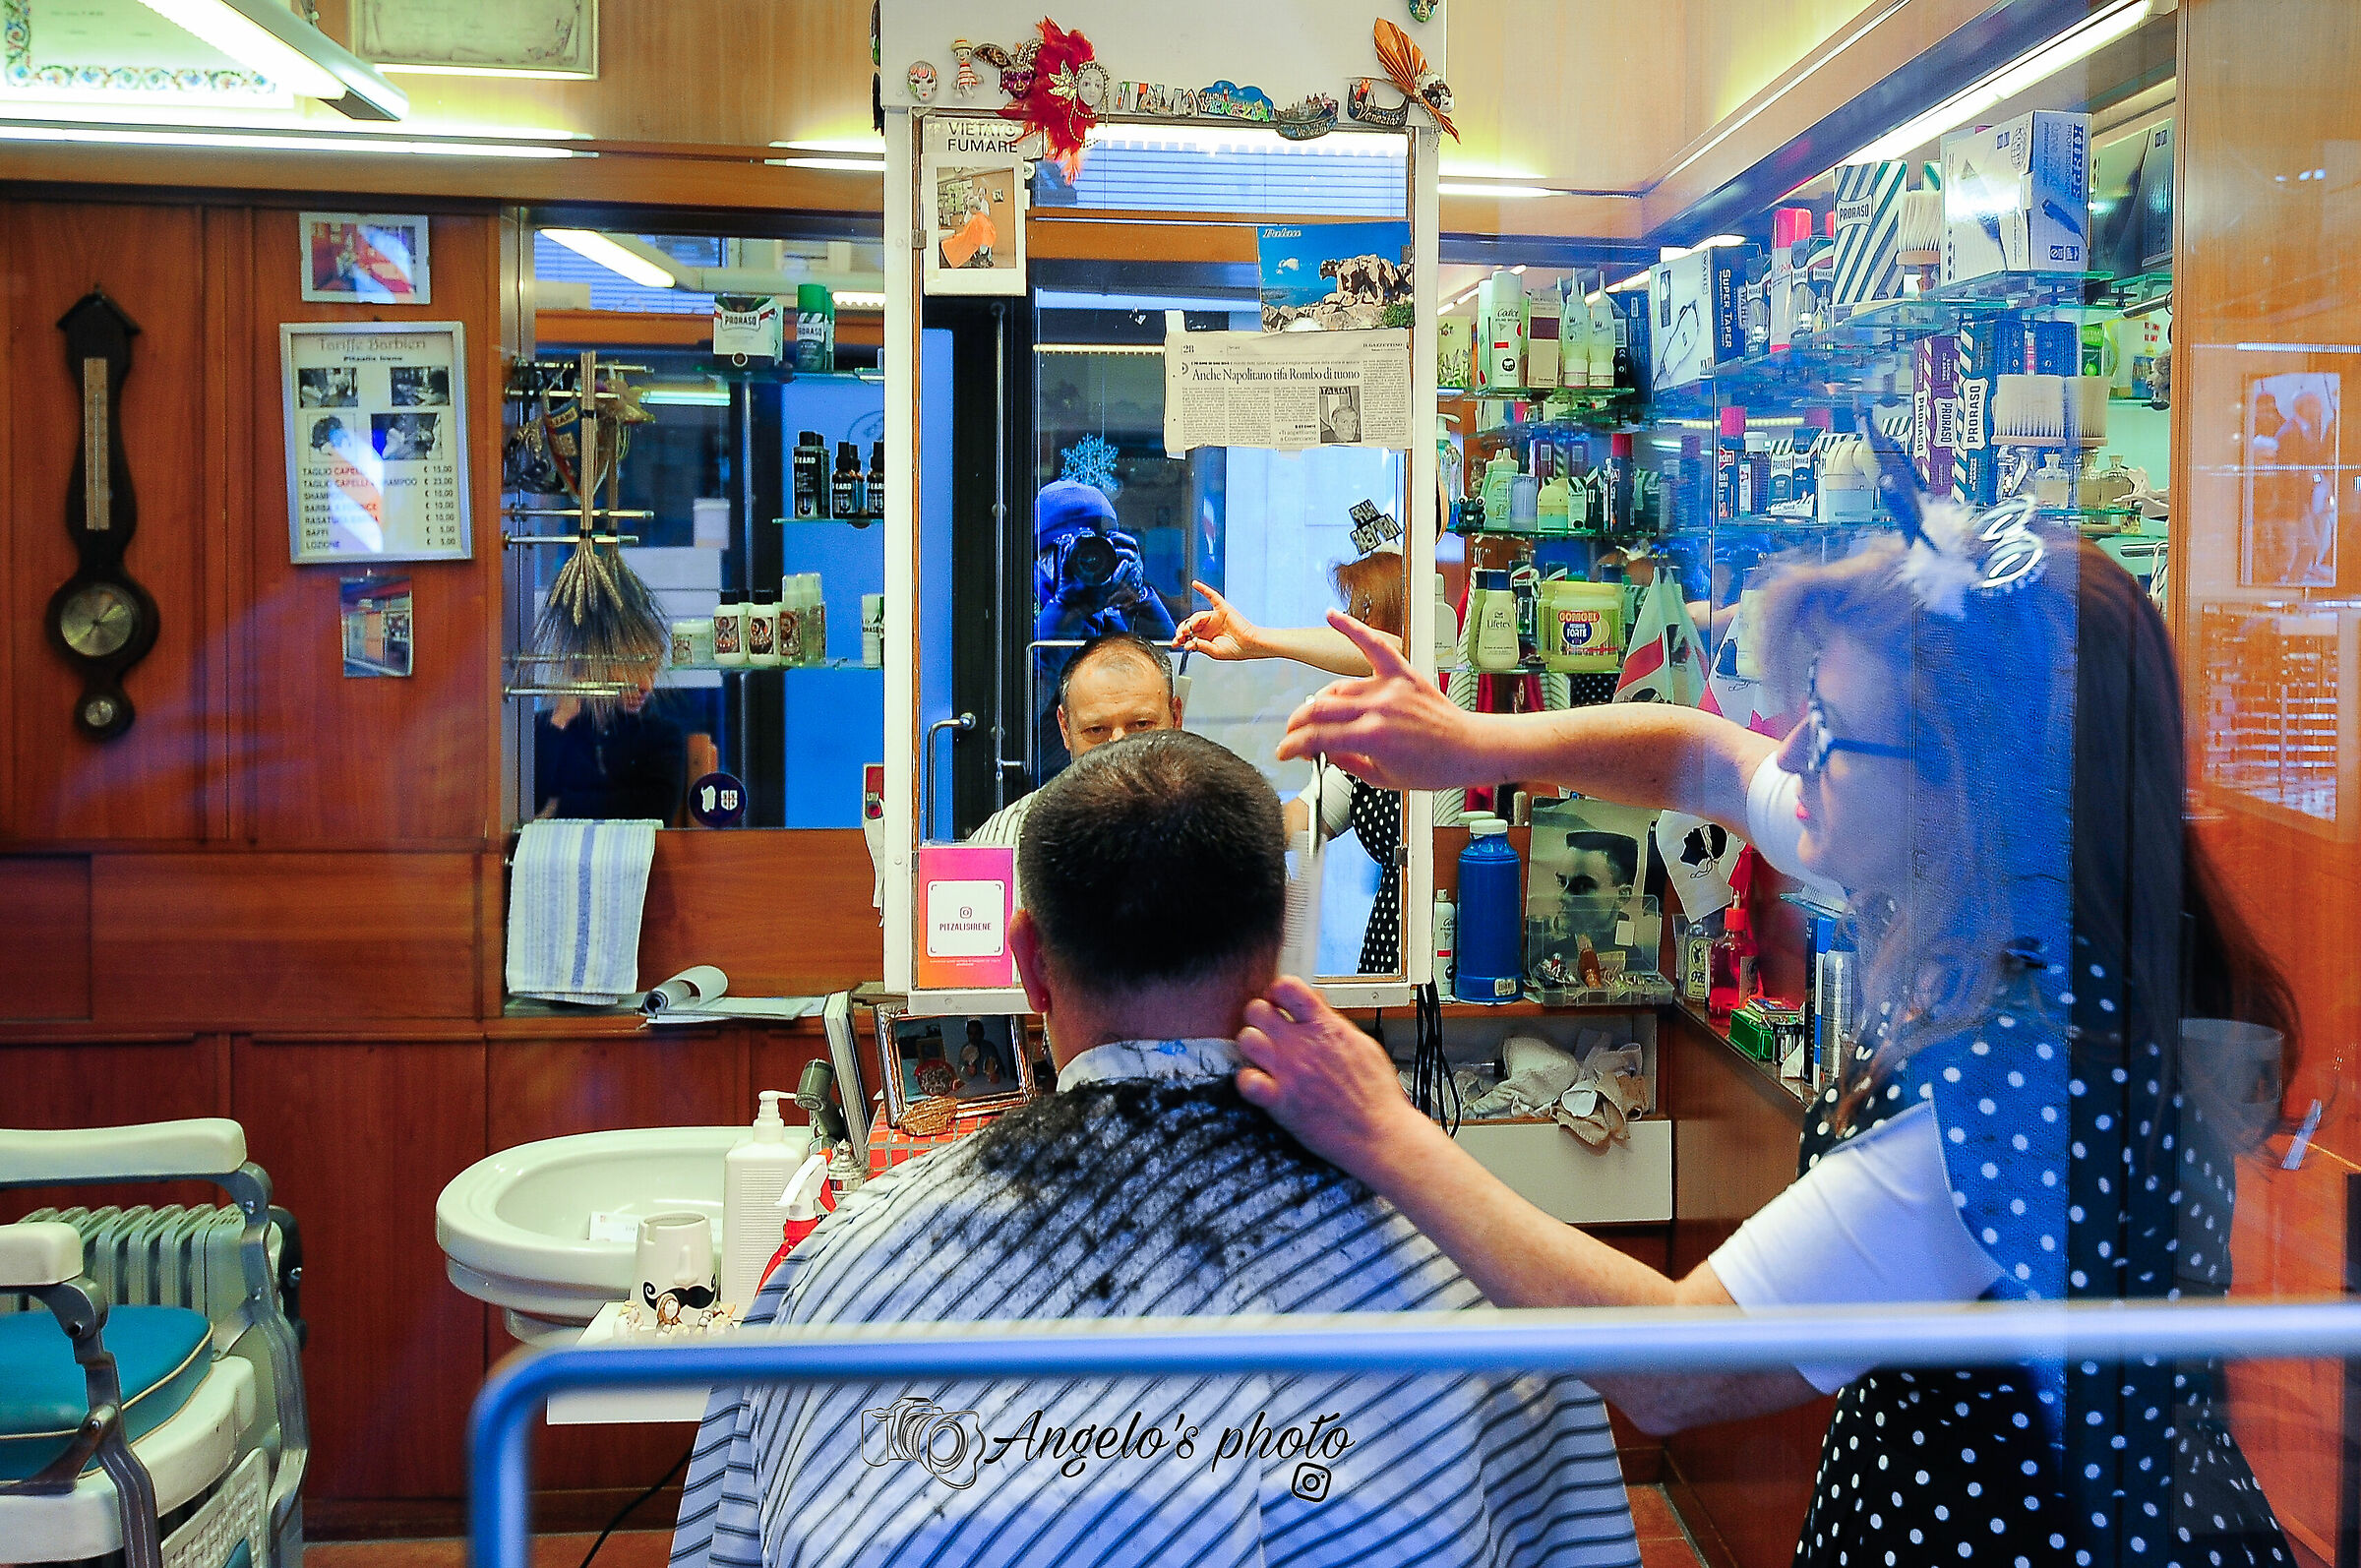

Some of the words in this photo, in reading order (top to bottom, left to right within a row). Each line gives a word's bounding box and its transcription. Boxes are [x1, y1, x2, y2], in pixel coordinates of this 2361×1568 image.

[1116, 82, 1199, 116] ITALIA
[1355, 101, 1398, 126] Venezia
[948, 121, 1016, 138] VIETATO
[947, 139, 1017, 153] FUMARE
[2072, 123, 2084, 199] KIEPE
[1839, 203, 1869, 222] PRORASO
[1722, 269, 1731, 308] SUPER
[725, 315, 757, 327] PRORASO
[1724, 312, 1732, 348] TAPER
[1183, 344, 1194, 353] 28
[1192, 367, 1221, 381] Anche
[1223, 367, 1272, 385] Napolitano
[1273, 366, 1288, 381] tifa
[1290, 367, 1322, 381] Rombo
[1323, 366, 1332, 380] di
[1333, 370, 1361, 380] tuono
[1940, 402, 1953, 443] PRORASO
[1968, 386, 1981, 443] PRORASO
[939, 923, 992, 932] PITZALISIRENE
